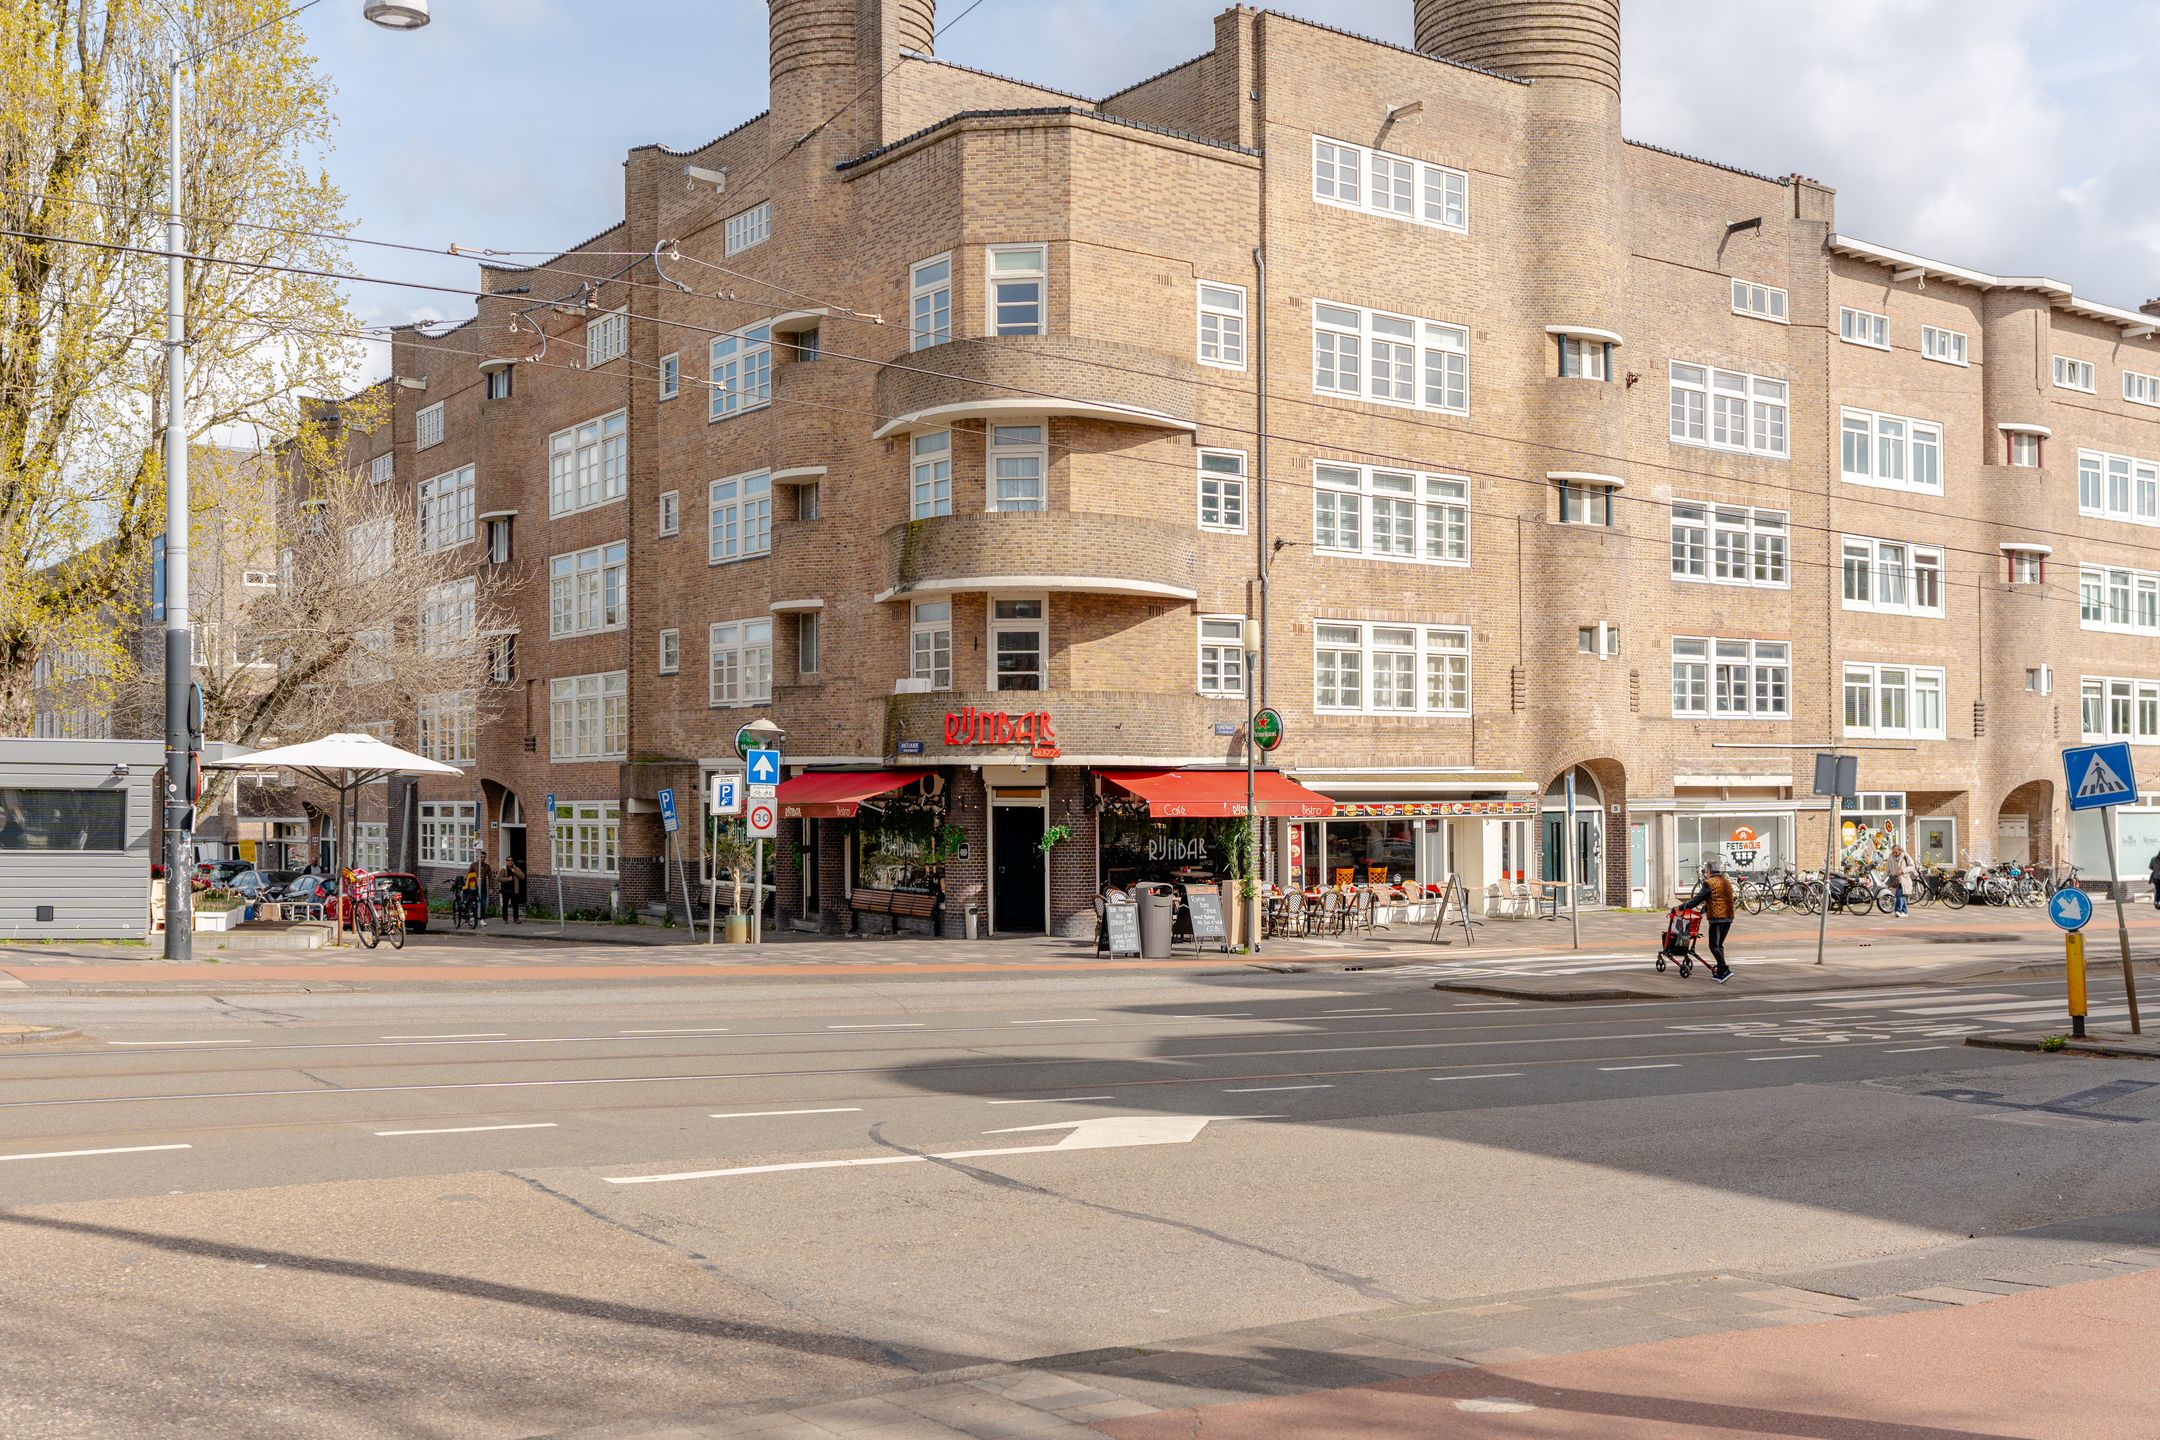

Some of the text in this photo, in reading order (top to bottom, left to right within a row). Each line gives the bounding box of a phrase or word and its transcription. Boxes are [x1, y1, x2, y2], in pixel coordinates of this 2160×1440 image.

[1163, 804, 1187, 816] Café
[755, 813, 769, 822] 30
[1665, 1021, 1891, 1043] BUS
